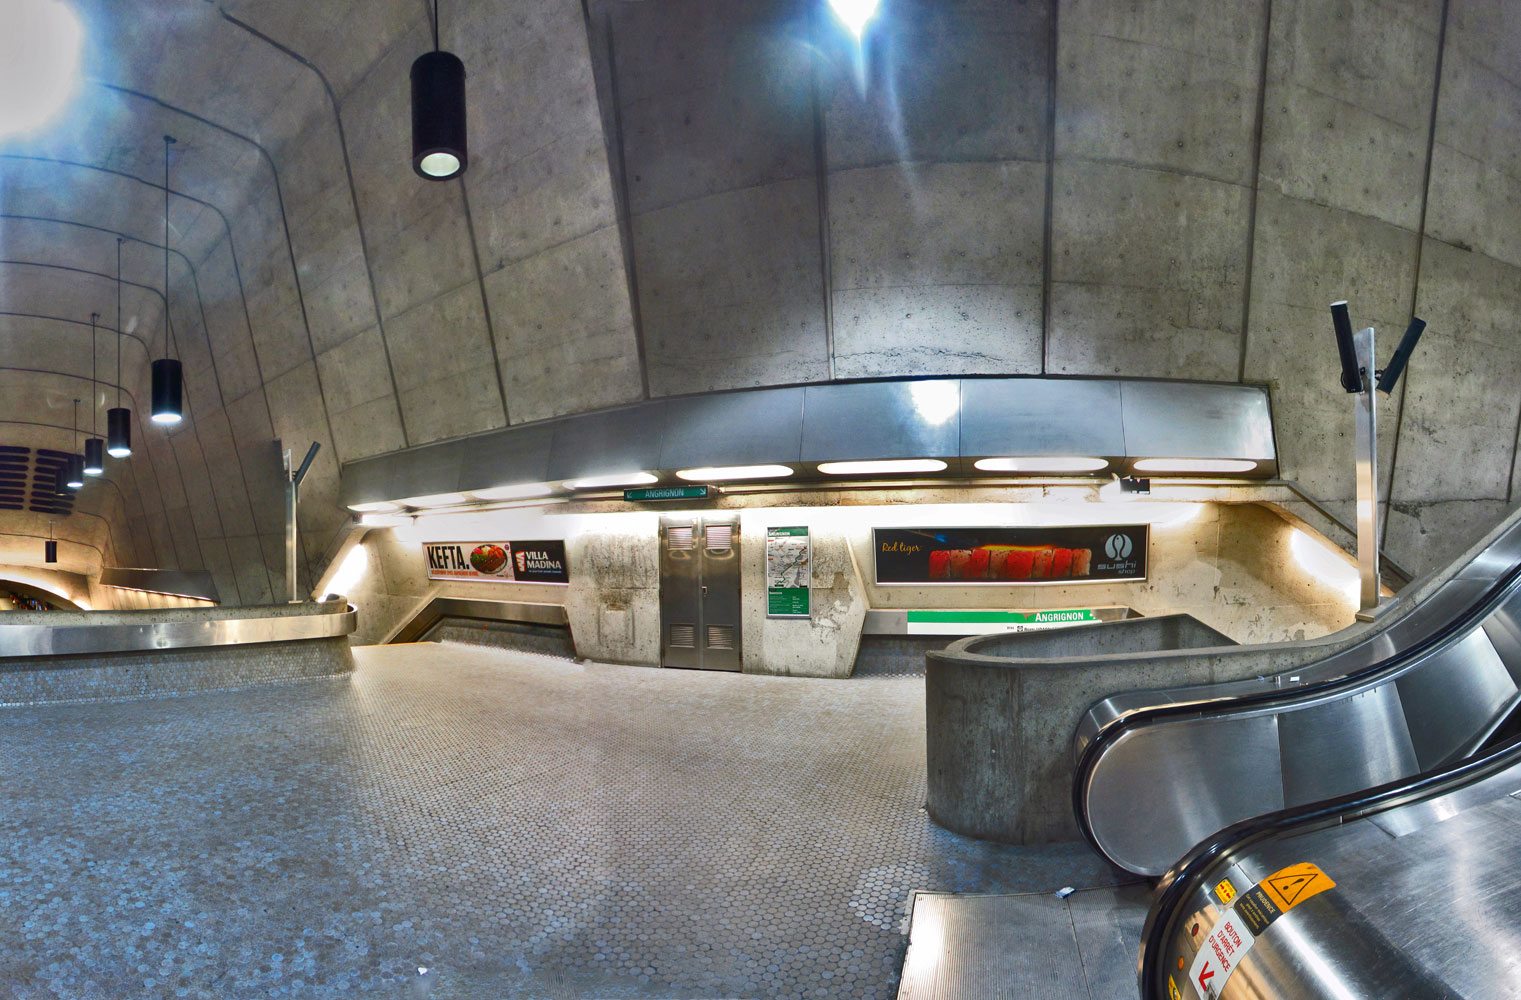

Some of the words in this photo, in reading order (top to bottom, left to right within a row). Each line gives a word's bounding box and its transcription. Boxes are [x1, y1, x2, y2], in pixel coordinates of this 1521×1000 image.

[645, 488, 684, 498] ANGRIGNON
[881, 541, 898, 552] Red
[427, 545, 470, 569] KEFTA.
[525, 551, 549, 560] VILLA
[526, 560, 562, 569] MADINA
[1097, 560, 1137, 570] sushi
[1035, 612, 1084, 622] ANGRIGNON
[1256, 891, 1276, 914] PRUDENCE
[1224, 921, 1242, 948] BOUTON
[1209, 935, 1231, 972] D'URGENCE
